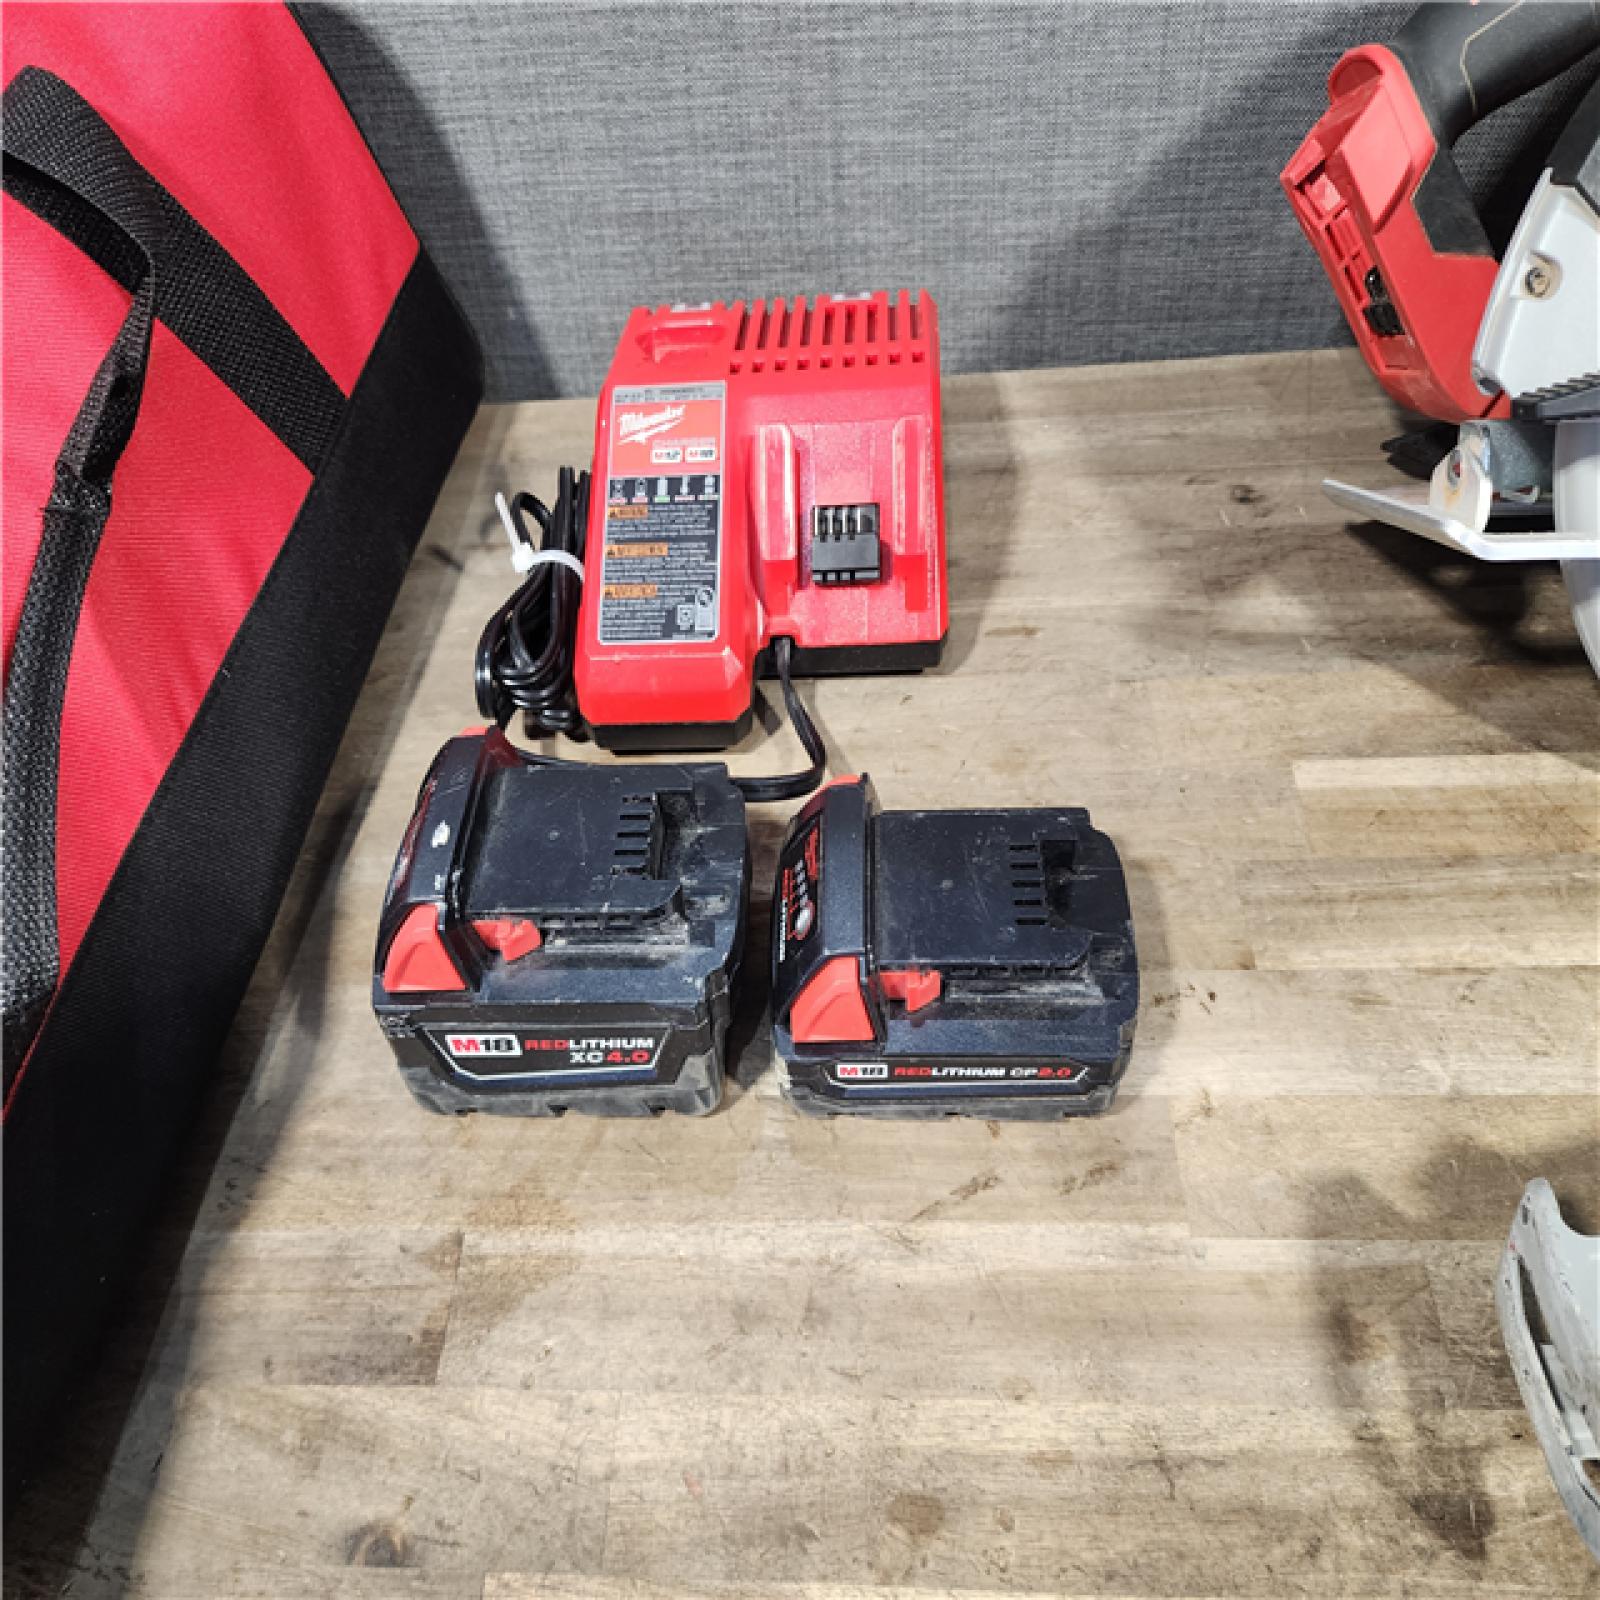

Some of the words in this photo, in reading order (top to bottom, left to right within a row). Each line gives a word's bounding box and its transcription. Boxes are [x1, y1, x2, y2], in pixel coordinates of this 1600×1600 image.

[450, 1037, 516, 1053] M18
[524, 1039, 654, 1051] REDLITHIUM
[837, 1065, 887, 1077] M18
[894, 1066, 1006, 1077] REDLITHIUM
